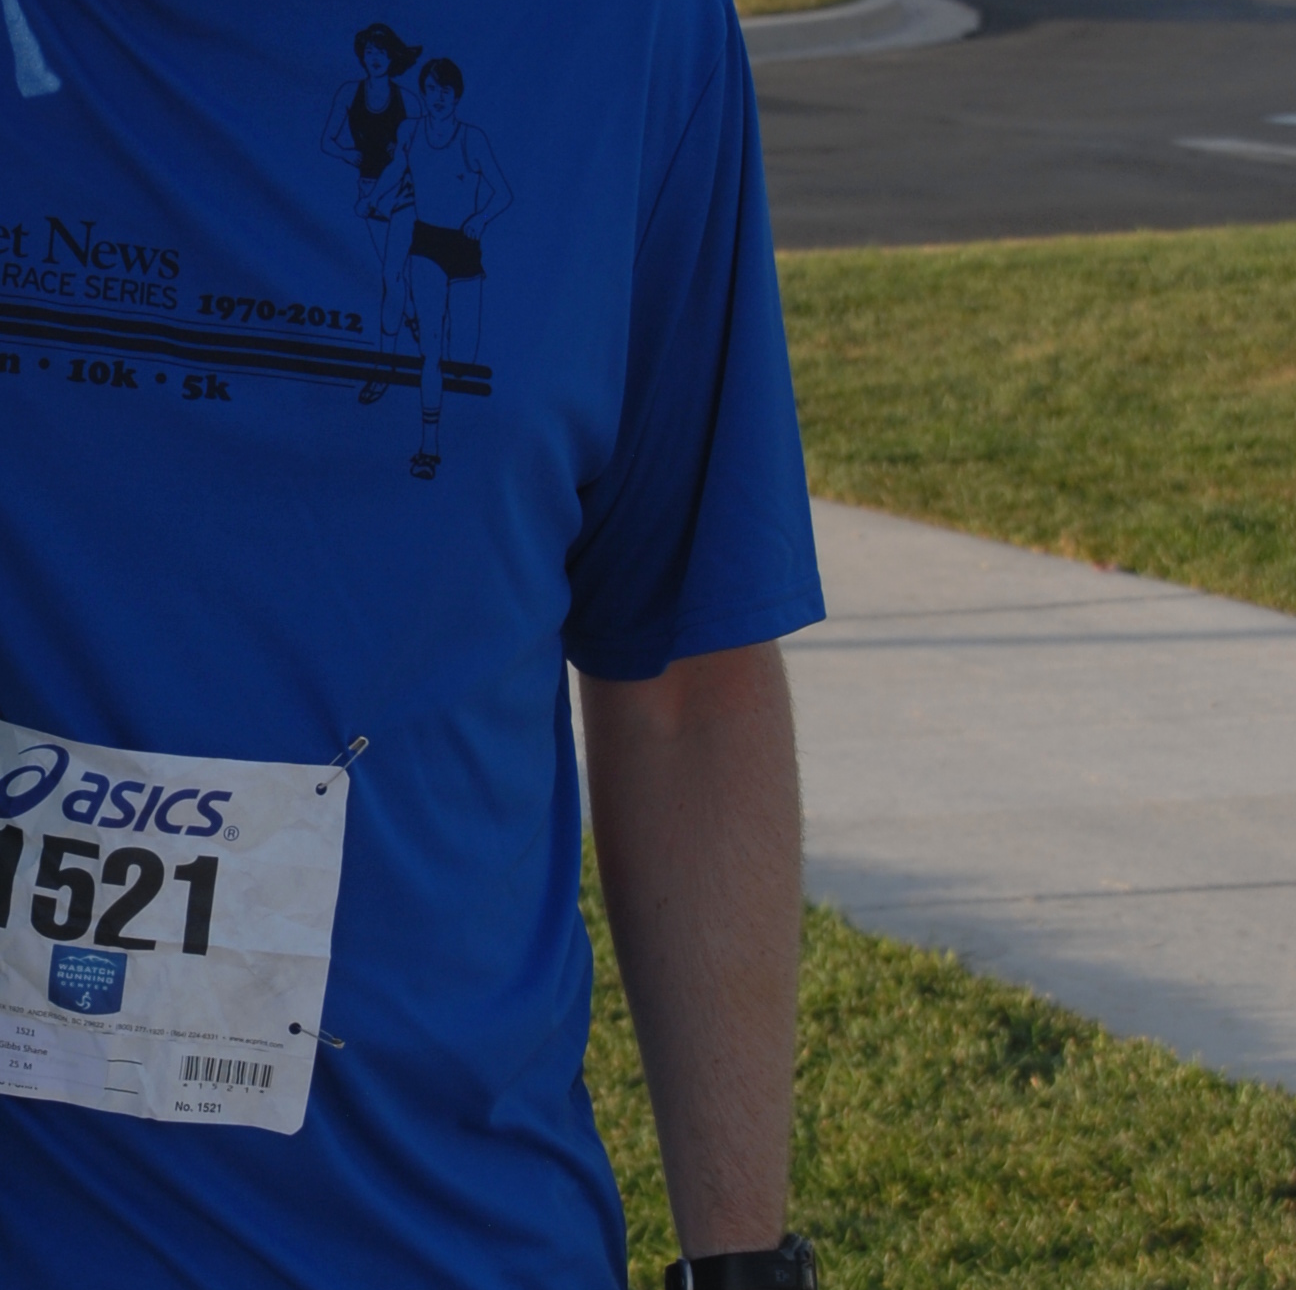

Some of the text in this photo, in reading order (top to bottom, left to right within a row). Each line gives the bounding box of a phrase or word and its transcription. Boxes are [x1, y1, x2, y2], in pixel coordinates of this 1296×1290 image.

[42, 216, 180, 279] News
[1, 262, 76, 296] RACE
[84, 274, 178, 310] SERIES
[196, 293, 363, 334] 1970-2012
[66, 358, 138, 389] 10k
[182, 373, 232, 402] 5k
[58, 963, 116, 976] WASATCH
[57, 970, 114, 985] RUNNING
[16, 1026, 36, 1037] 1521
[23, 1044, 48, 1056] Shane
[9, 1059, 32, 1070] 25 M
[175, 1101, 222, 1113] No. 1521
